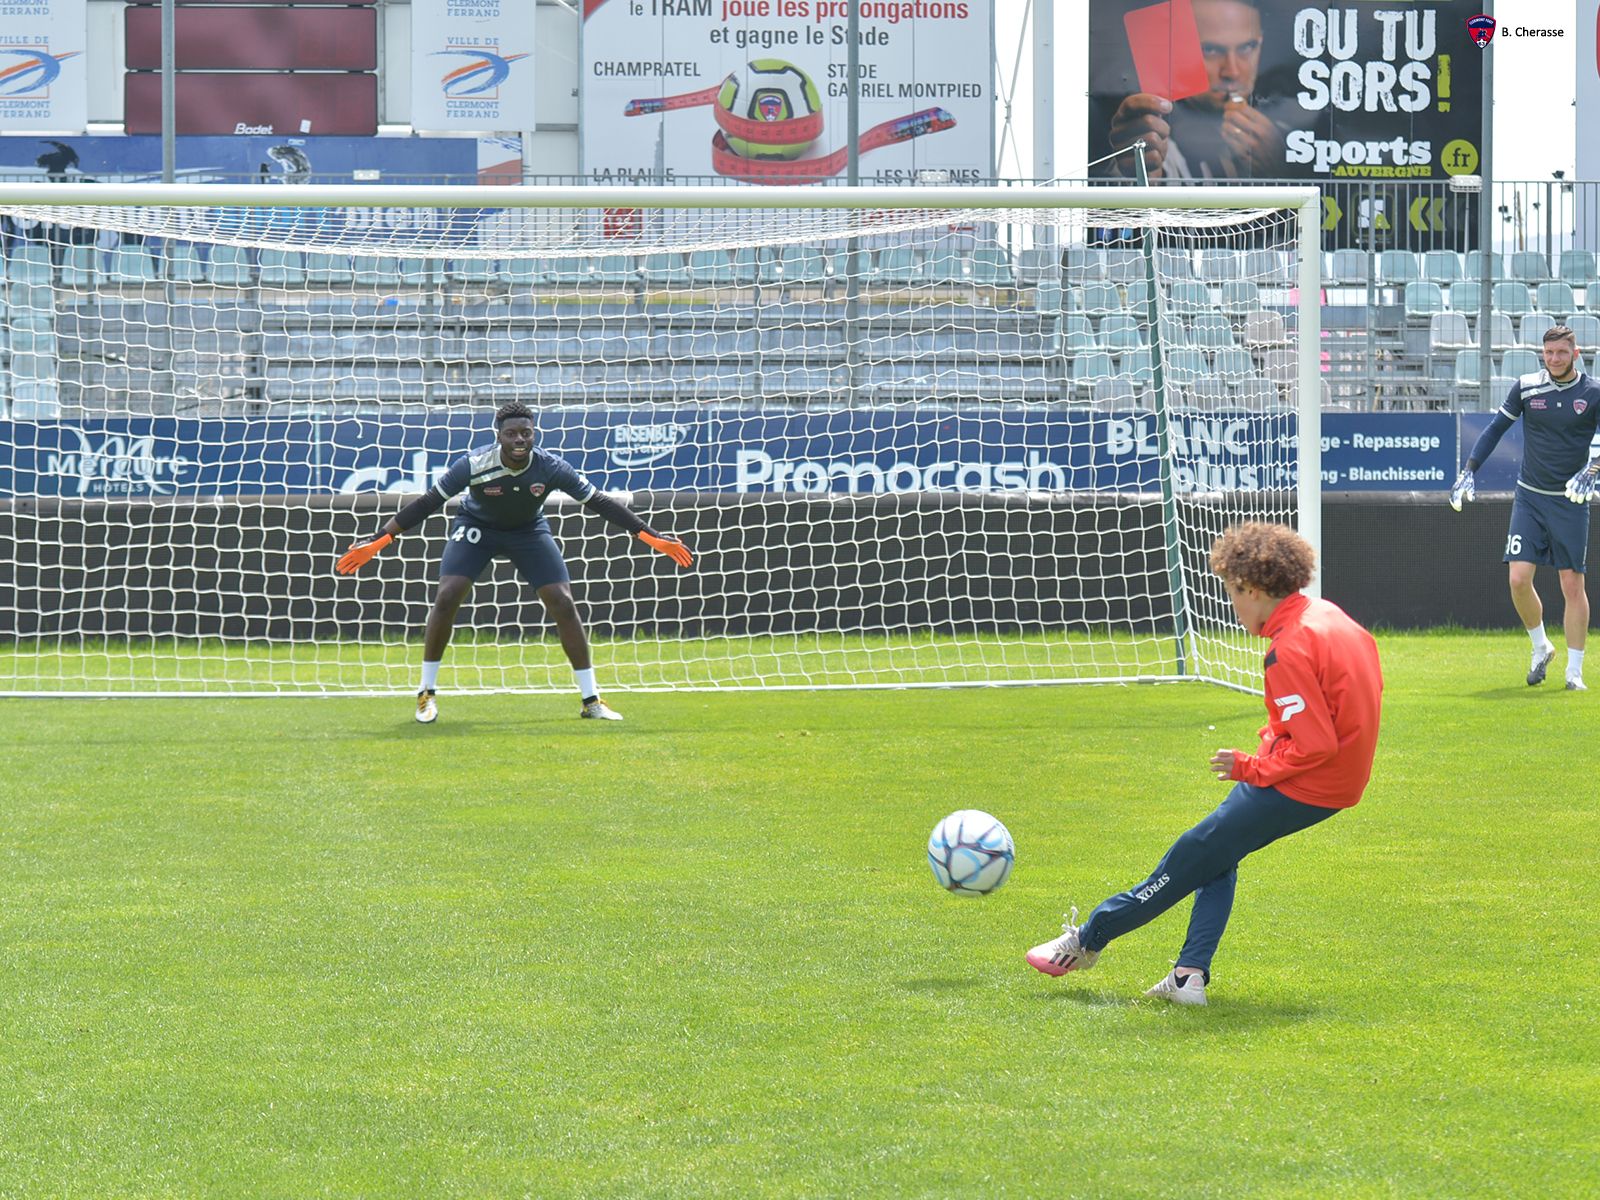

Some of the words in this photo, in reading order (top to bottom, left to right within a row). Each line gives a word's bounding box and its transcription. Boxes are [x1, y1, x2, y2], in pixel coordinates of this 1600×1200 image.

[0, 7, 50, 15] ERRAND
[447, 8, 500, 17] FERRAND
[630, 0, 643, 16] le
[651, 0, 712, 16] TRAM
[721, 0, 770, 21] joue
[777, 0, 810, 17] les
[816, 0, 969, 24] proongations
[34, 36, 49, 44] DE
[447, 37, 480, 45] VILLE
[484, 38, 499, 46] DE
[710, 27, 729, 44] et
[736, 30, 798, 49] gagne
[806, 26, 824, 45] le
[1373, 9, 1437, 61] TU
[593, 61, 702, 77] CHAMPRATEL
[827, 63, 878, 79] STDE
[827, 82, 894, 98] GARIEL
[899, 83, 982, 98] MONTPIED
[1297, 60, 1432, 112] SORS
[446, 101, 499, 109] CLERMONT
[0, 110, 51, 118] ERRAND
[446, 110, 500, 119] FERRAND
[1285, 130, 1432, 173] Sports
[617, 167, 676, 183] PLAIE
[876, 169, 903, 184] LES
[908, 169, 980, 184] VNES
[1106, 420, 1250, 455] BLANC
[1281, 434, 1340, 452] Lage
[1353, 433, 1440, 452] Repassage
[47, 454, 189, 477] Mercure
[736, 449, 1066, 494] Promocash
[1349, 466, 1445, 481] Blanchisserie
[93, 484, 145, 493] HOTELS
[451, 525, 482, 544] 40
